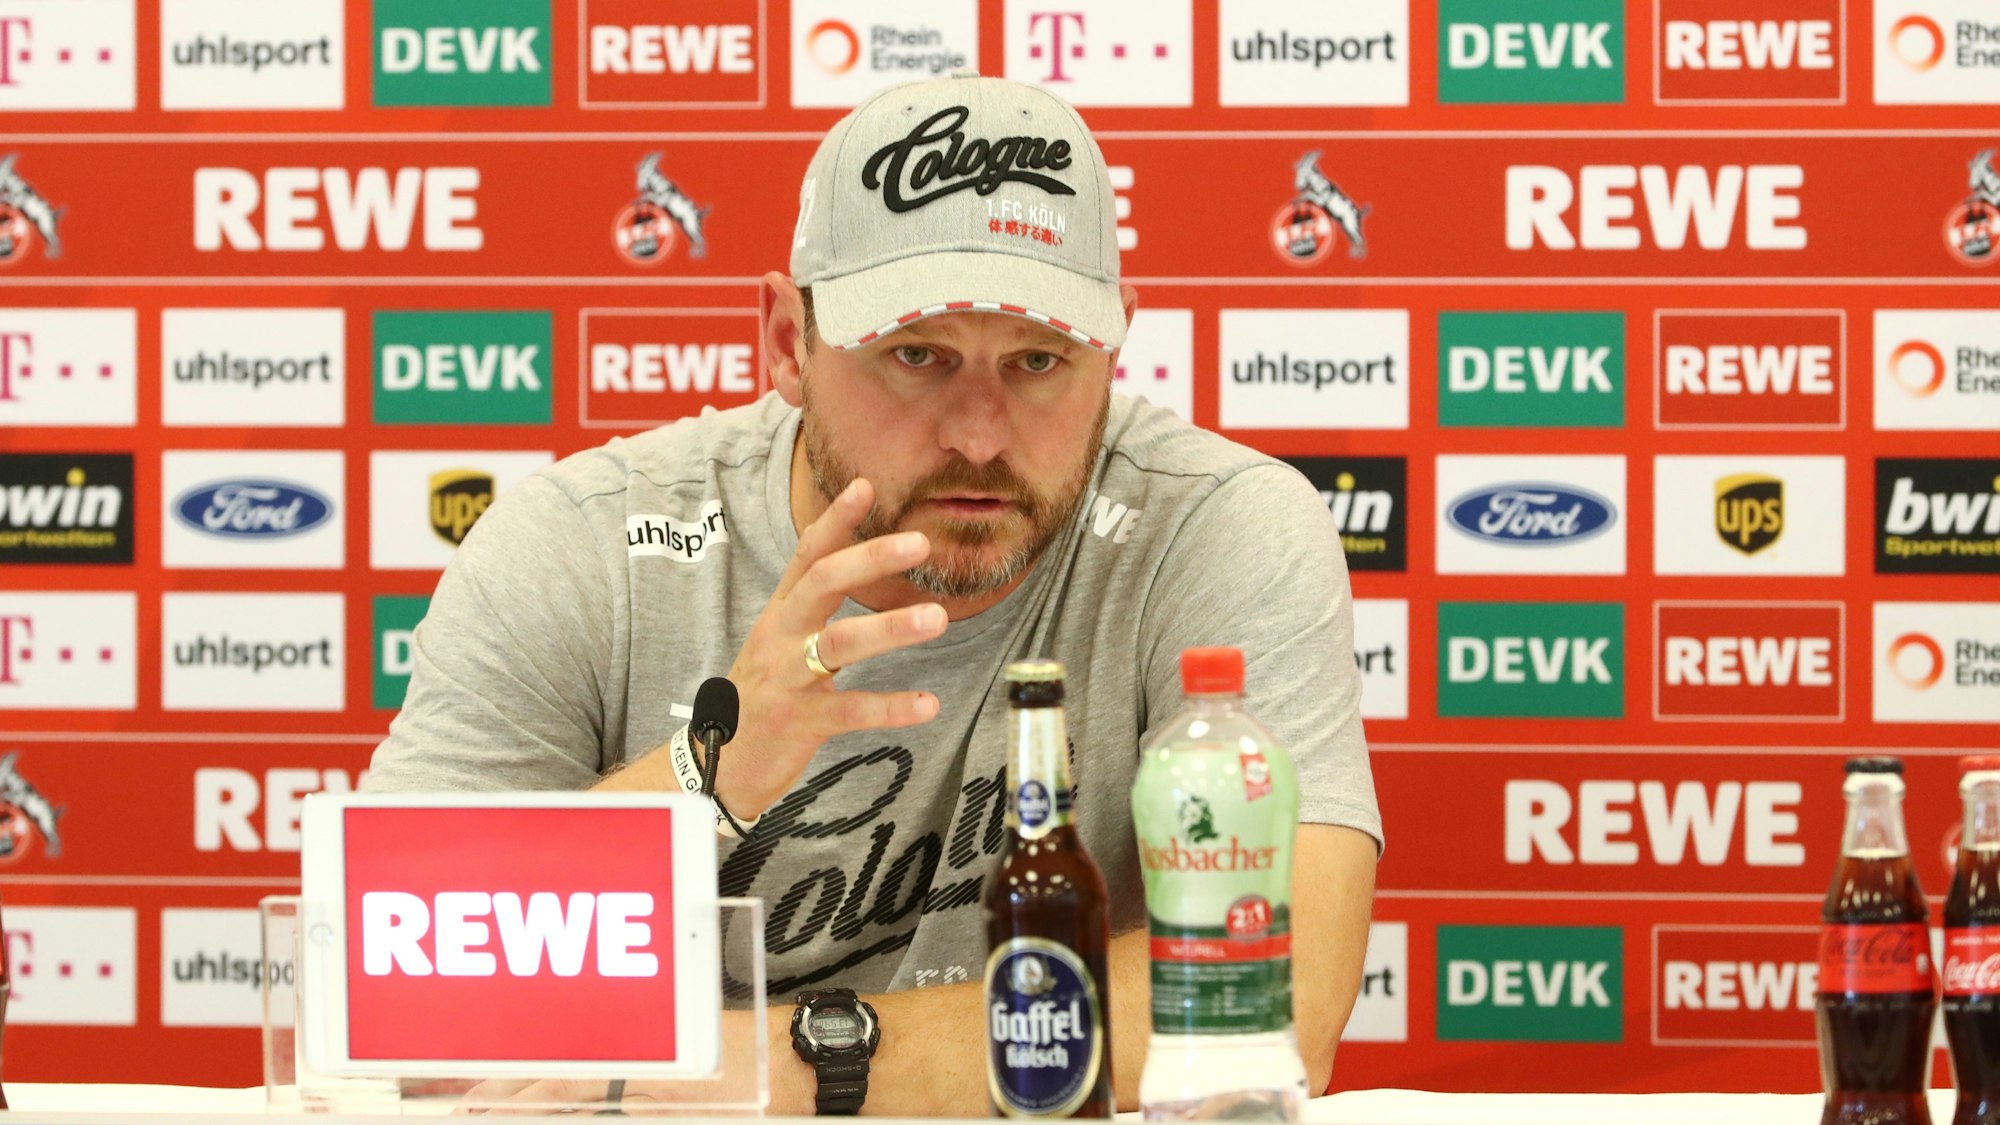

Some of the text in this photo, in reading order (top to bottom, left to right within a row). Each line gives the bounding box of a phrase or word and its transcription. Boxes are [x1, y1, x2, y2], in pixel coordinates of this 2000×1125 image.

[173, 35, 331, 73] uhlsport
[381, 26, 541, 74] DEVK
[590, 24, 754, 75] REWE
[870, 26, 941, 45] Rhein
[1232, 30, 1396, 69] uhlsport
[1448, 22, 1613, 69] DEVK
[1665, 19, 1834, 70] REWE
[871, 49, 966, 74] Energie
[861, 105, 1077, 214] Cologne
[193, 166, 485, 252] REWE
[1001, 199, 1023, 220] FC
[1029, 202, 1066, 234] KÖLN
[1504, 164, 1808, 251] REWE
[173, 351, 331, 389] uhlsport
[381, 344, 541, 391] DEVK
[590, 343, 755, 393] REWE
[1232, 352, 1396, 391] uhlsport
[1448, 346, 1613, 393] DEVK
[1665, 344, 1834, 395] REWE
[0, 468, 122, 527] win
[203, 486, 303, 531] Ford
[1478, 492, 1583, 536] Ford
[1719, 497, 1781, 546] ups
[173, 634, 331, 673] uhlsport
[1448, 636, 1612, 684] DEVK
[1665, 636, 1833, 686] REWE
[674, 745, 691, 777] KEIN
[1504, 779, 1806, 866] REWE
[362, 890, 660, 977] REWE
[1447, 960, 1611, 1007] DEVK
